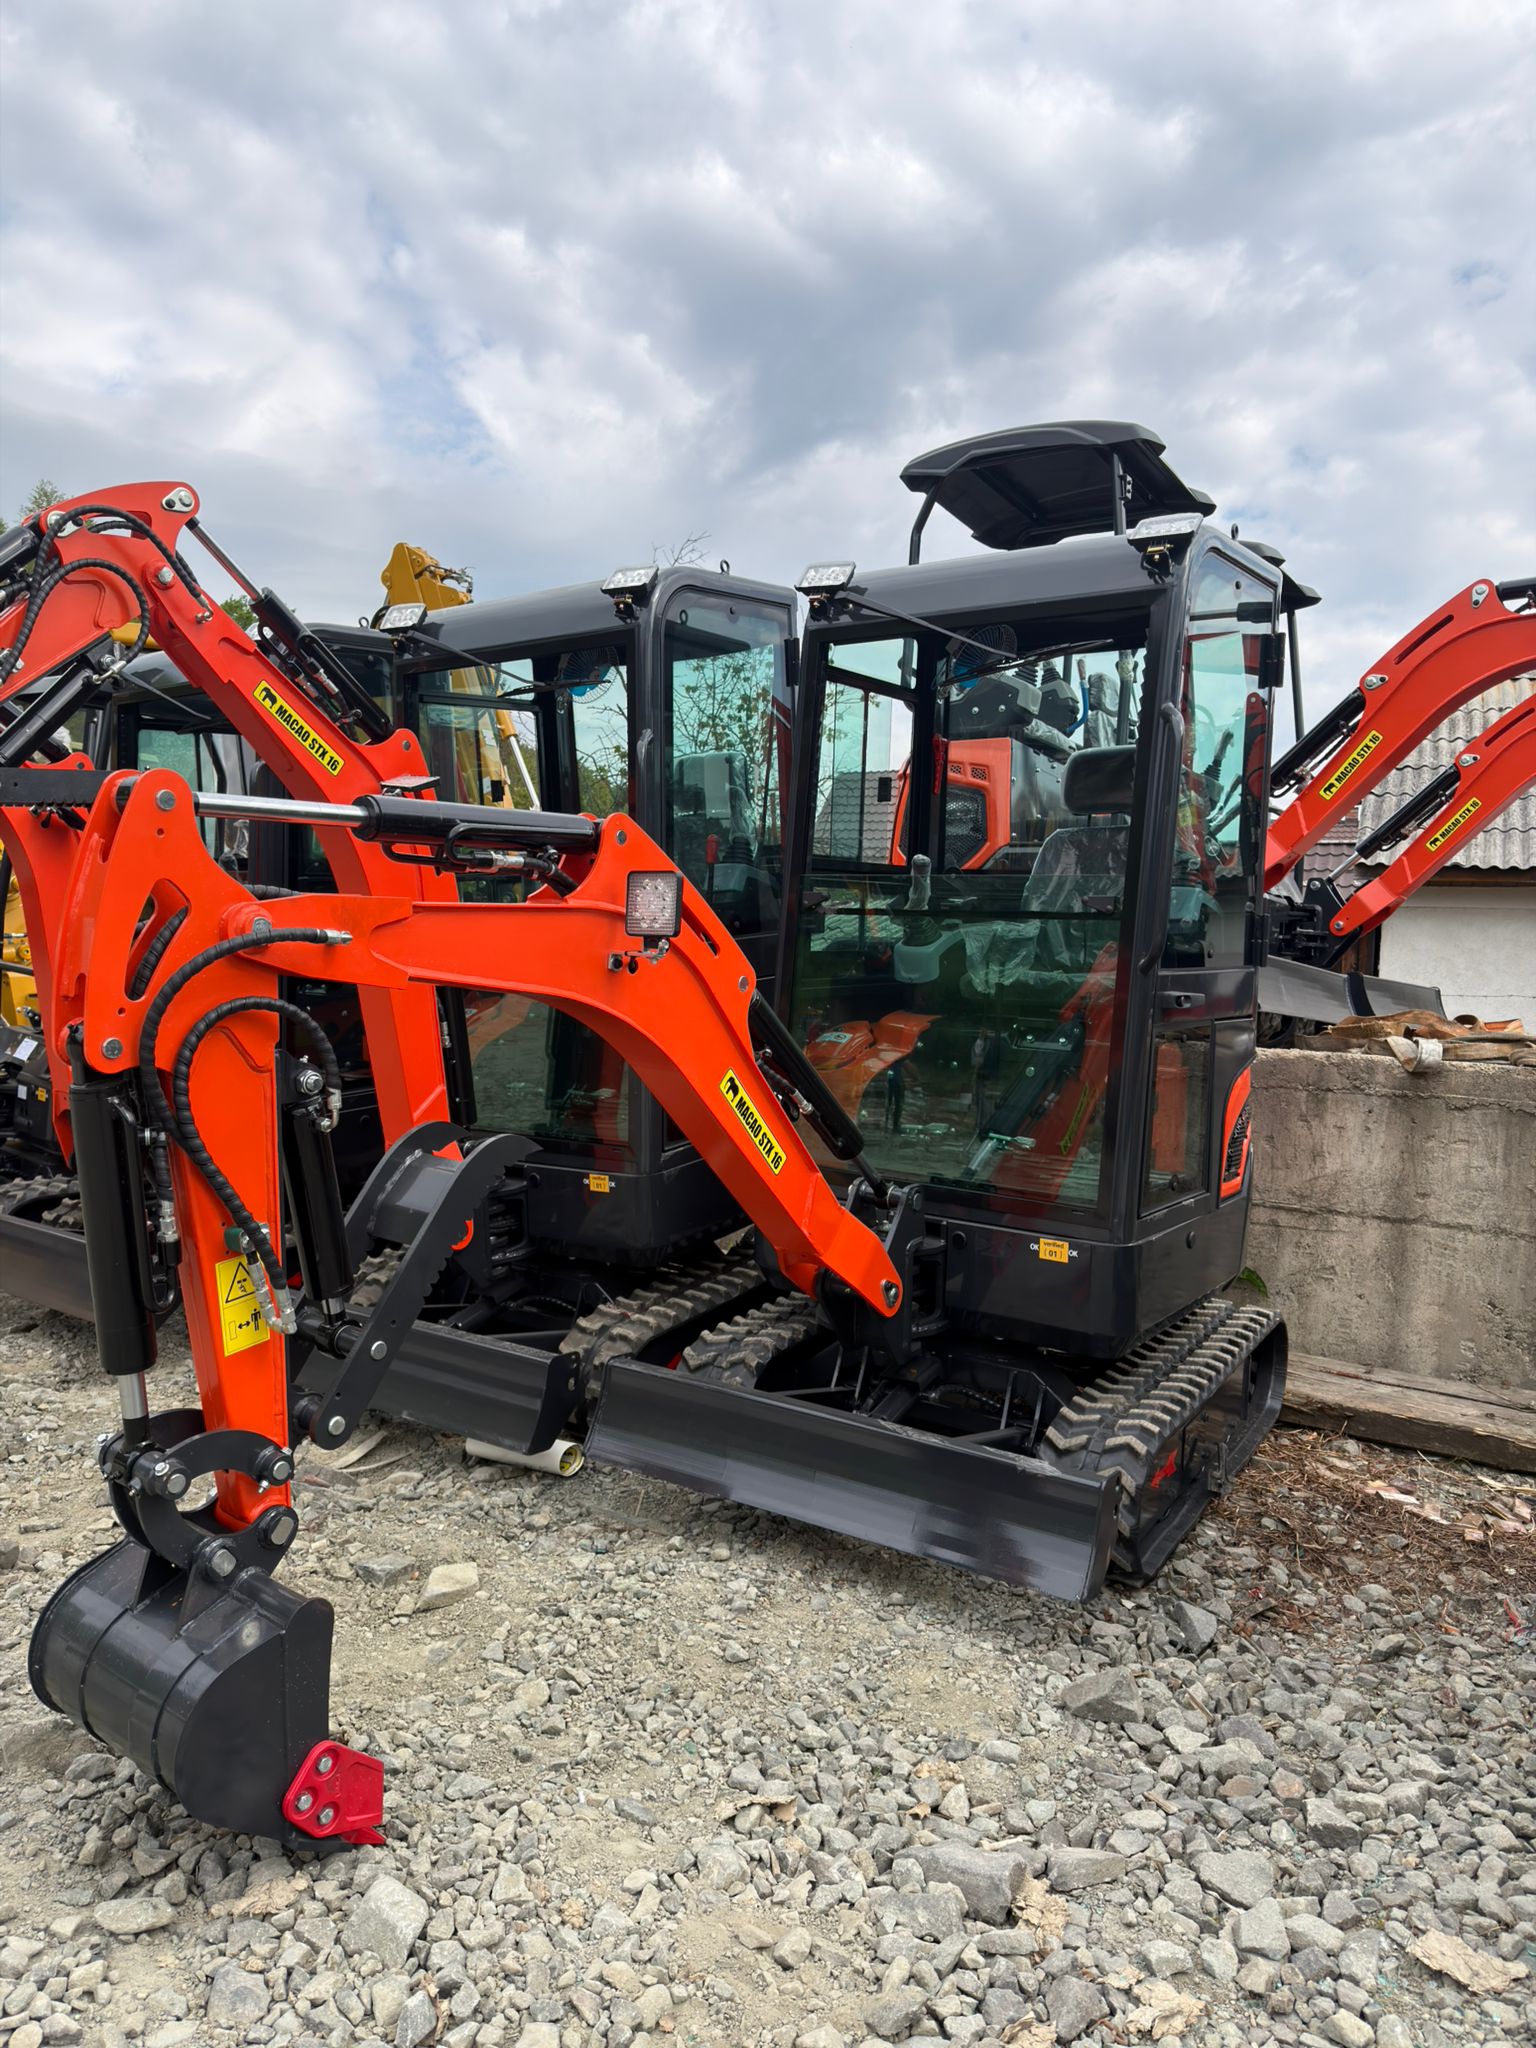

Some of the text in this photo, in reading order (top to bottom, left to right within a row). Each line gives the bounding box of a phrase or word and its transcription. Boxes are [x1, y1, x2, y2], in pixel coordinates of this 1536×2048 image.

[275, 704, 340, 772] MACAO STX 16
[1334, 733, 1380, 785] MACAO STX 16
[1439, 800, 1480, 840] MACAO STX 16
[735, 1096, 782, 1170] MACAO STX 16
[1043, 1241, 1065, 1249] verified
[1068, 1249, 1079, 1258] OK
